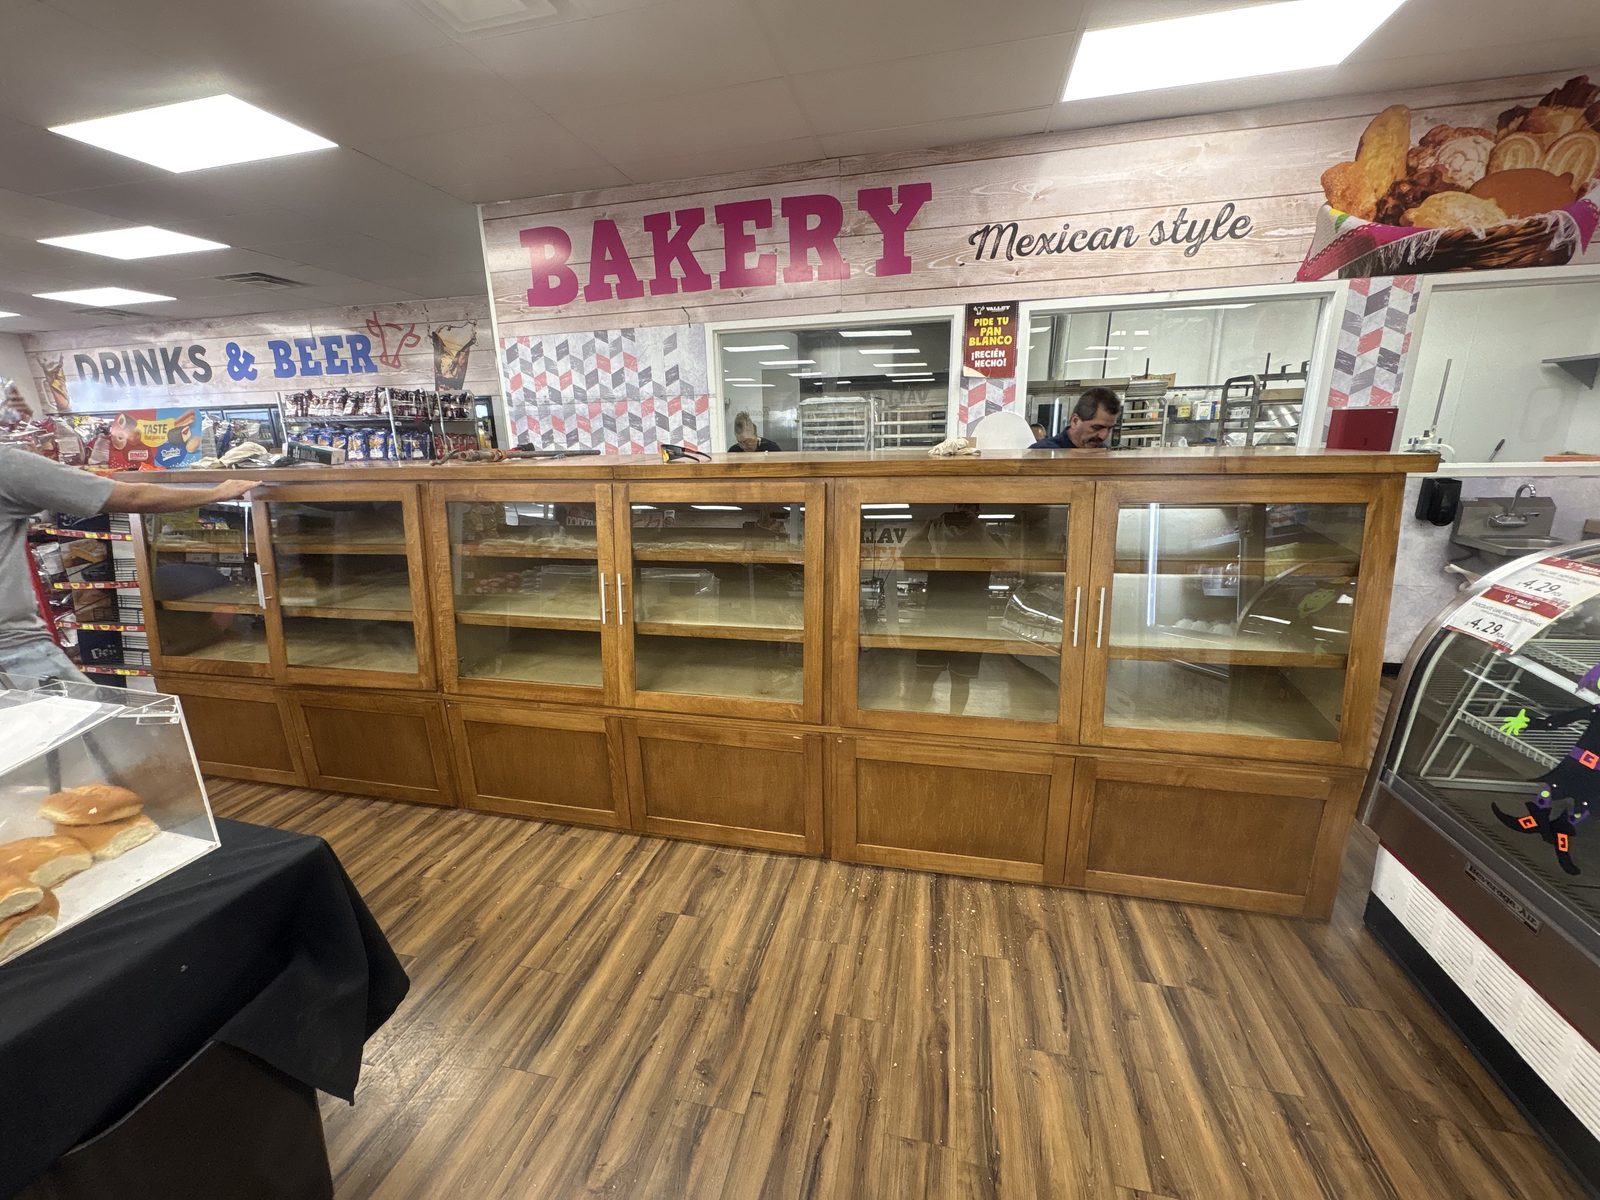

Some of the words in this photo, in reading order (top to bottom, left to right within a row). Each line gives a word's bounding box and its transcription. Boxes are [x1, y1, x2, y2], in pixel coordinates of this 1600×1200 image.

[968, 222, 1140, 261] Mexican
[1148, 202, 1253, 258] style
[520, 182, 932, 307] BAKERY
[974, 317, 994, 326] PIDE
[997, 316, 1009, 325] TU
[980, 327, 1002, 337] PAN
[968, 335, 1013, 346] BLANCO
[971, 348, 1005, 360] ¡RECIÉN
[73, 344, 213, 386] DRINKS
[225, 342, 258, 381] &
[268, 334, 378, 378] BEER
[975, 358, 1007, 368] HECHO!
[143, 424, 168, 434] TASTE
